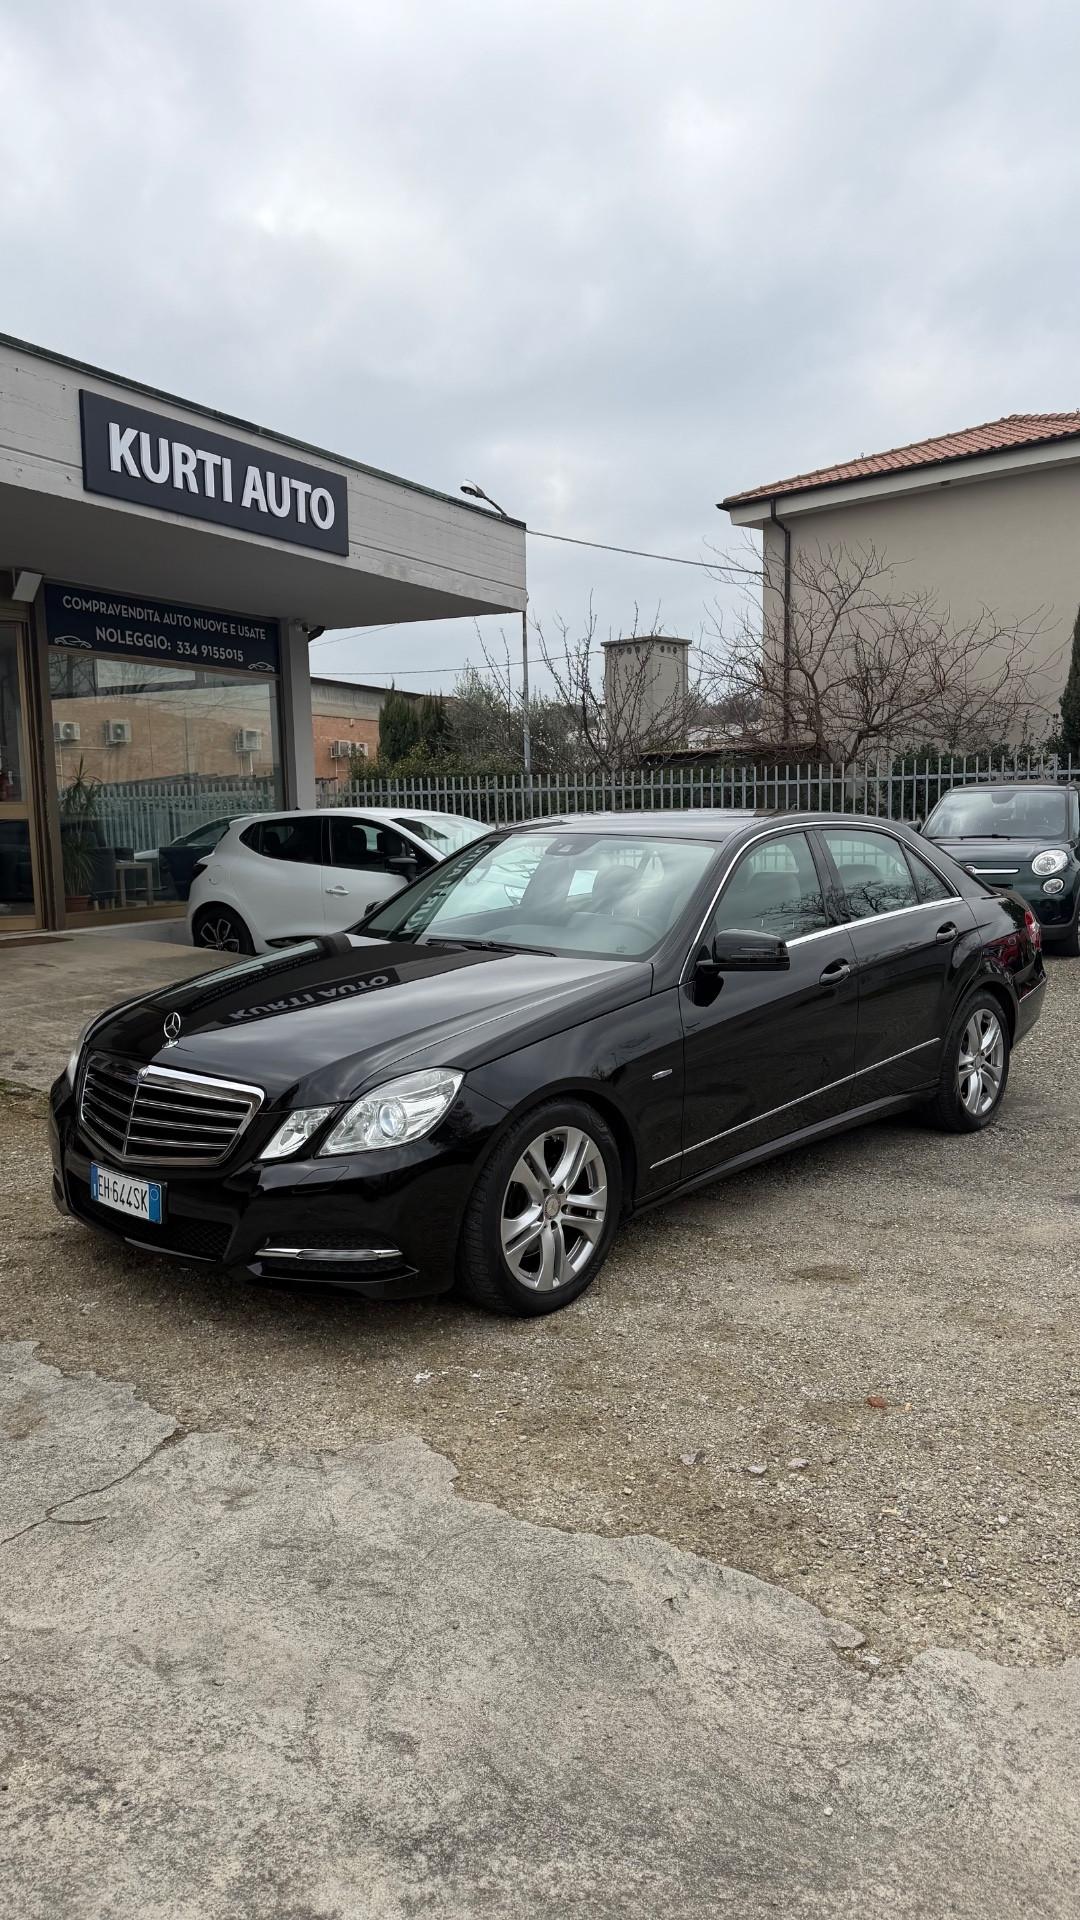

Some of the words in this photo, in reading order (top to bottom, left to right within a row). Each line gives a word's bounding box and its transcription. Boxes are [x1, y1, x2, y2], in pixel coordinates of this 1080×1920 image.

[108, 422, 232, 503] KURTI
[241, 465, 335, 530] AUTO
[62, 595, 160, 623] COMPRAVENDITA
[162, 612, 192, 628] AUTO
[193, 617, 228, 634] NUOVE
[229, 623, 237, 636] E
[237, 625, 266, 640] USATE
[95, 626, 171, 651] NOLEGGIO:
[176, 640, 198, 657] 334
[201, 644, 244, 662] 9155015
